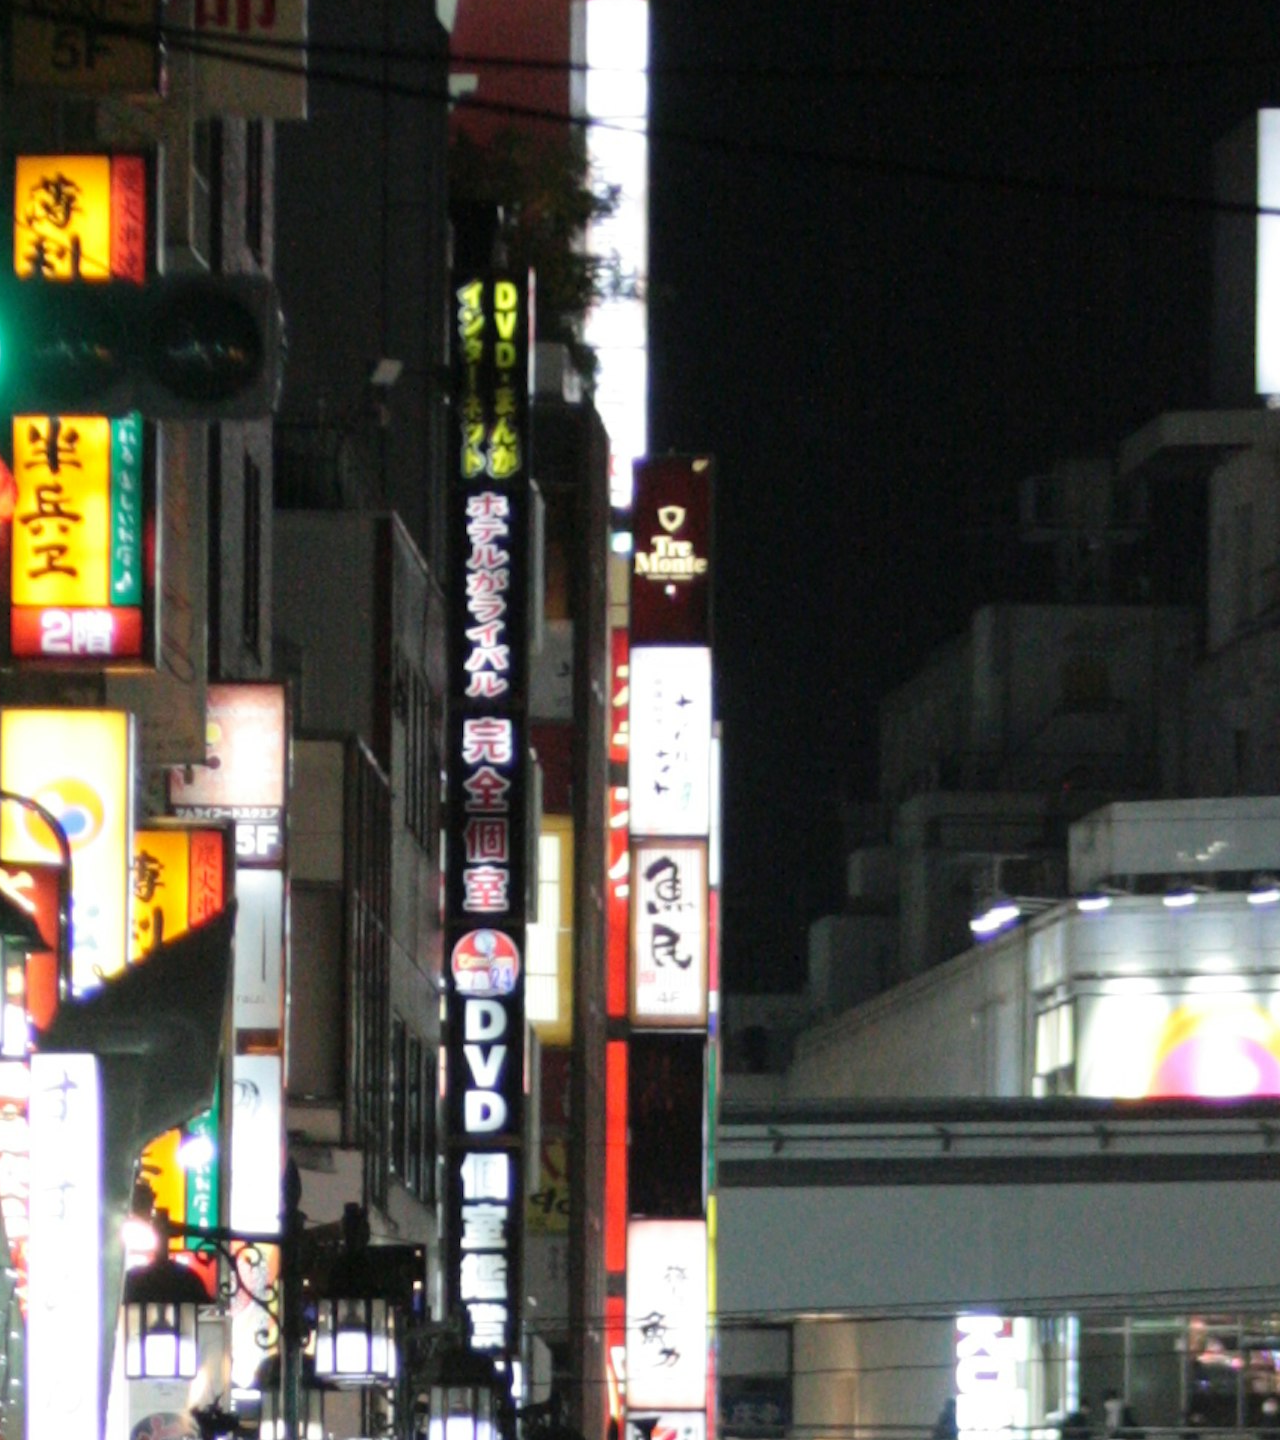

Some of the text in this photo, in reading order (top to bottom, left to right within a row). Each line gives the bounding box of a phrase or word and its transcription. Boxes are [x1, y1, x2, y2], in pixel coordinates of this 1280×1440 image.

[634, 551, 708, 574] Monte
[650, 535, 694, 557] Tre
[40, 610, 114, 655] 2階
[463, 492, 512, 914] ホテルがライバル 完全個室
[235, 824, 278, 856] 5F
[643, 855, 695, 970] 魚民
[463, 998, 509, 1134] DVD
